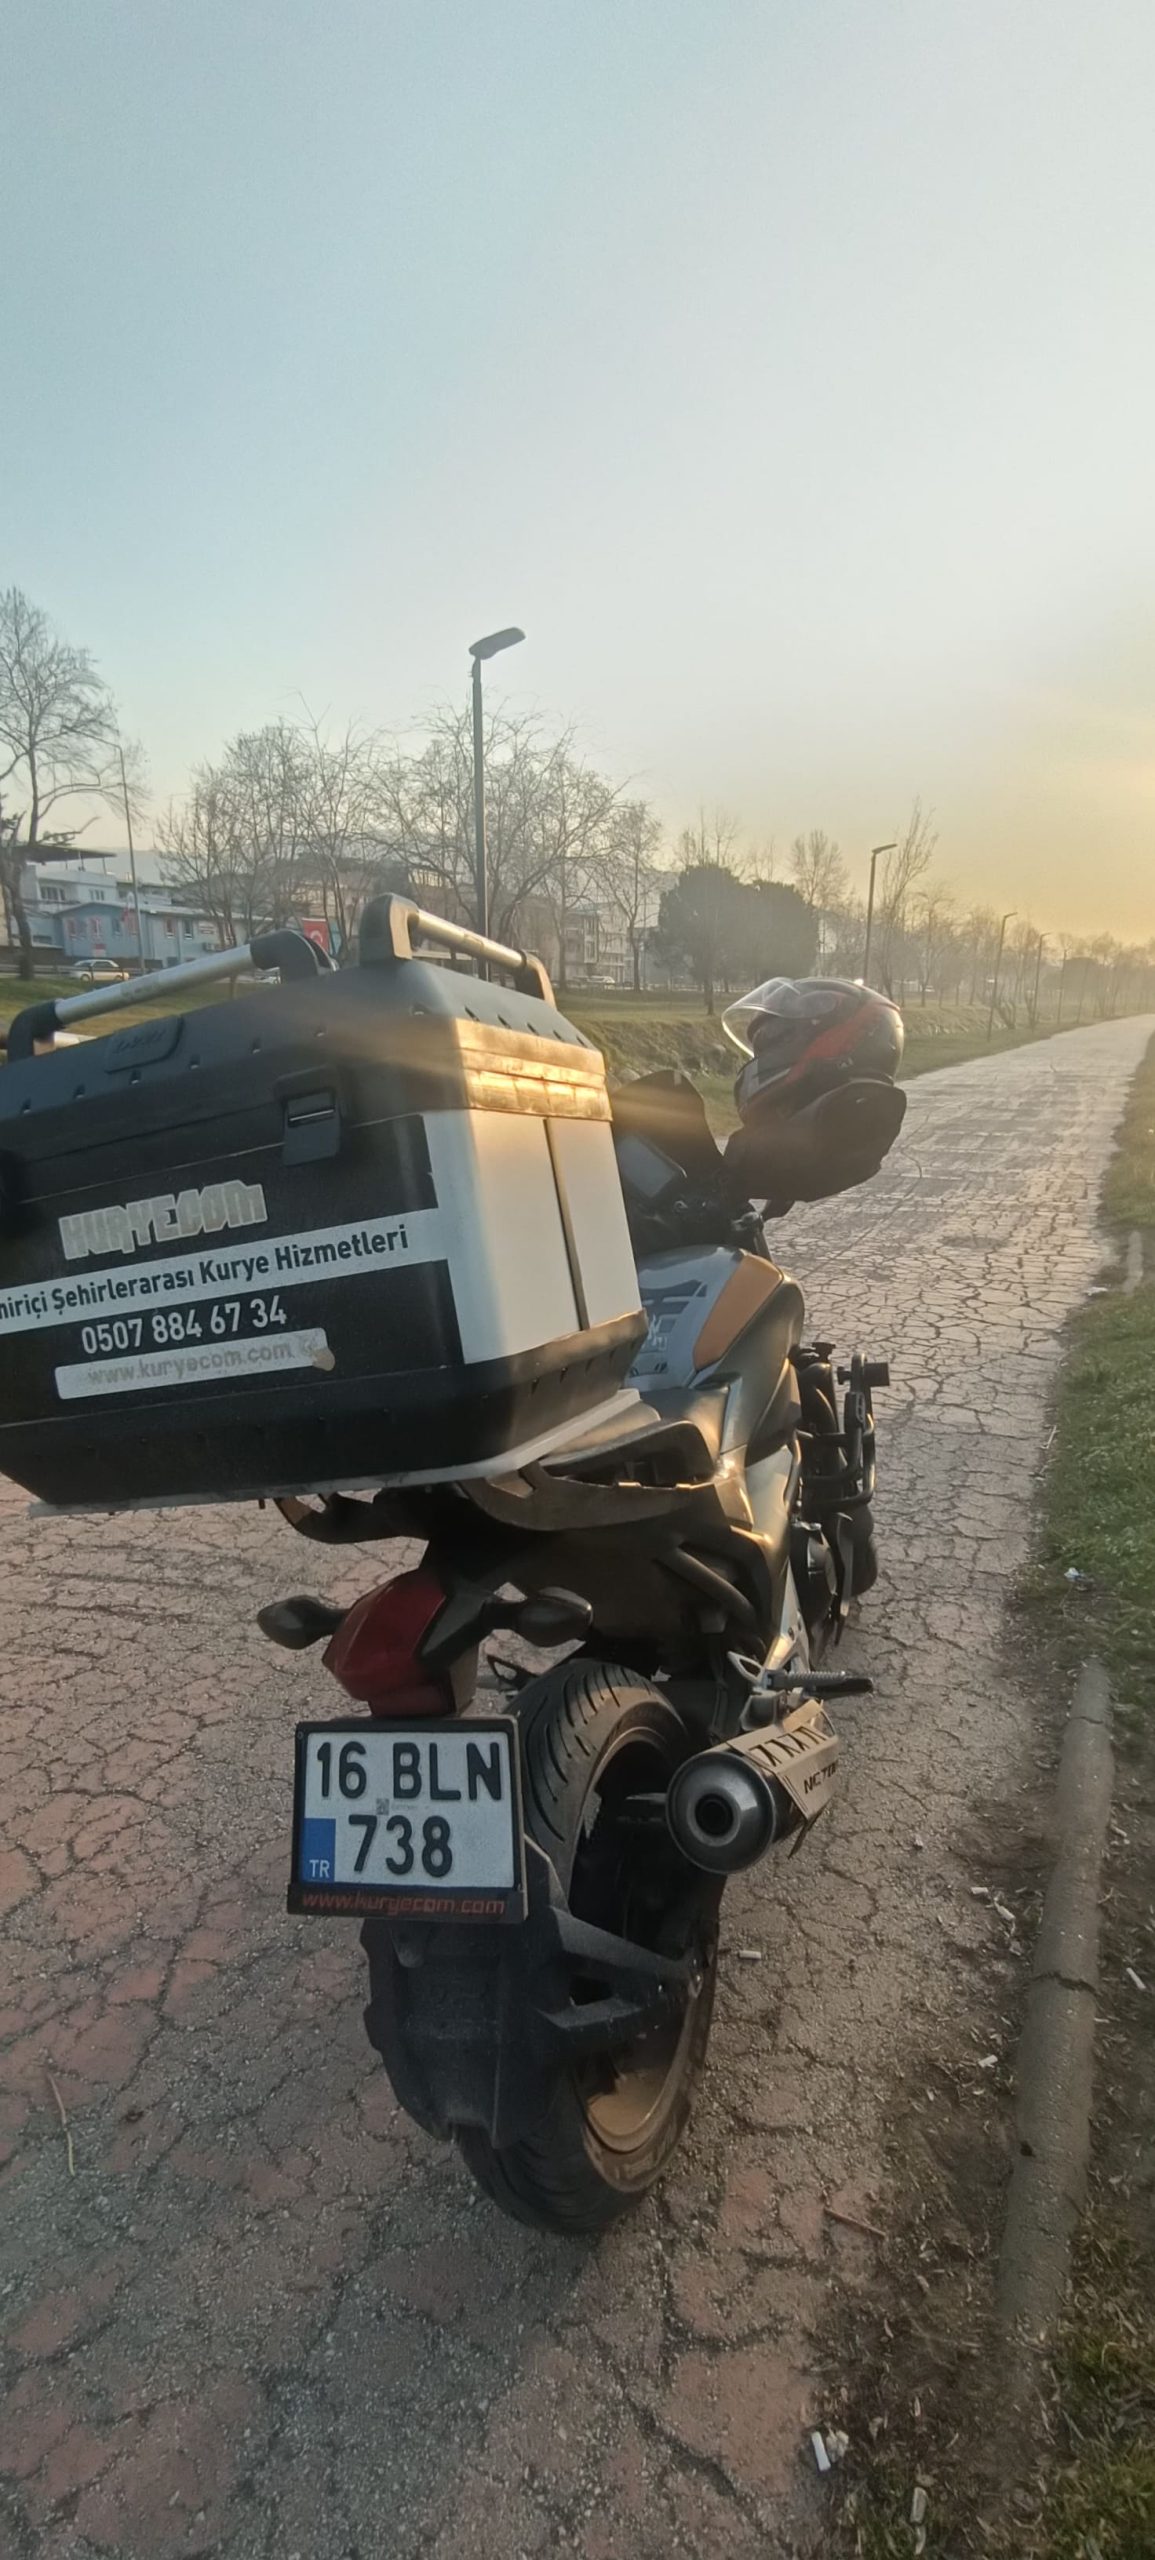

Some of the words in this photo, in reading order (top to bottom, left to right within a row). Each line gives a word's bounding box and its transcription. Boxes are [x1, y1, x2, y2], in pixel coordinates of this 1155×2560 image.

[51, 1269, 195, 1316] Şehirlerarası
[199, 1254, 269, 1282] Kurye
[274, 1224, 409, 1270] Hizmetleri
[81, 1318, 143, 1354] 0507
[151, 1309, 202, 1343] 884
[210, 1302, 241, 1335] 67
[250, 1295, 287, 1328] 34
[317, 1741, 367, 1799] 16
[392, 1741, 502, 1802] BLN
[309, 1859, 330, 1879] TR
[348, 1814, 453, 1878] 738
[302, 1890, 505, 1916] www.kuryecom.com
